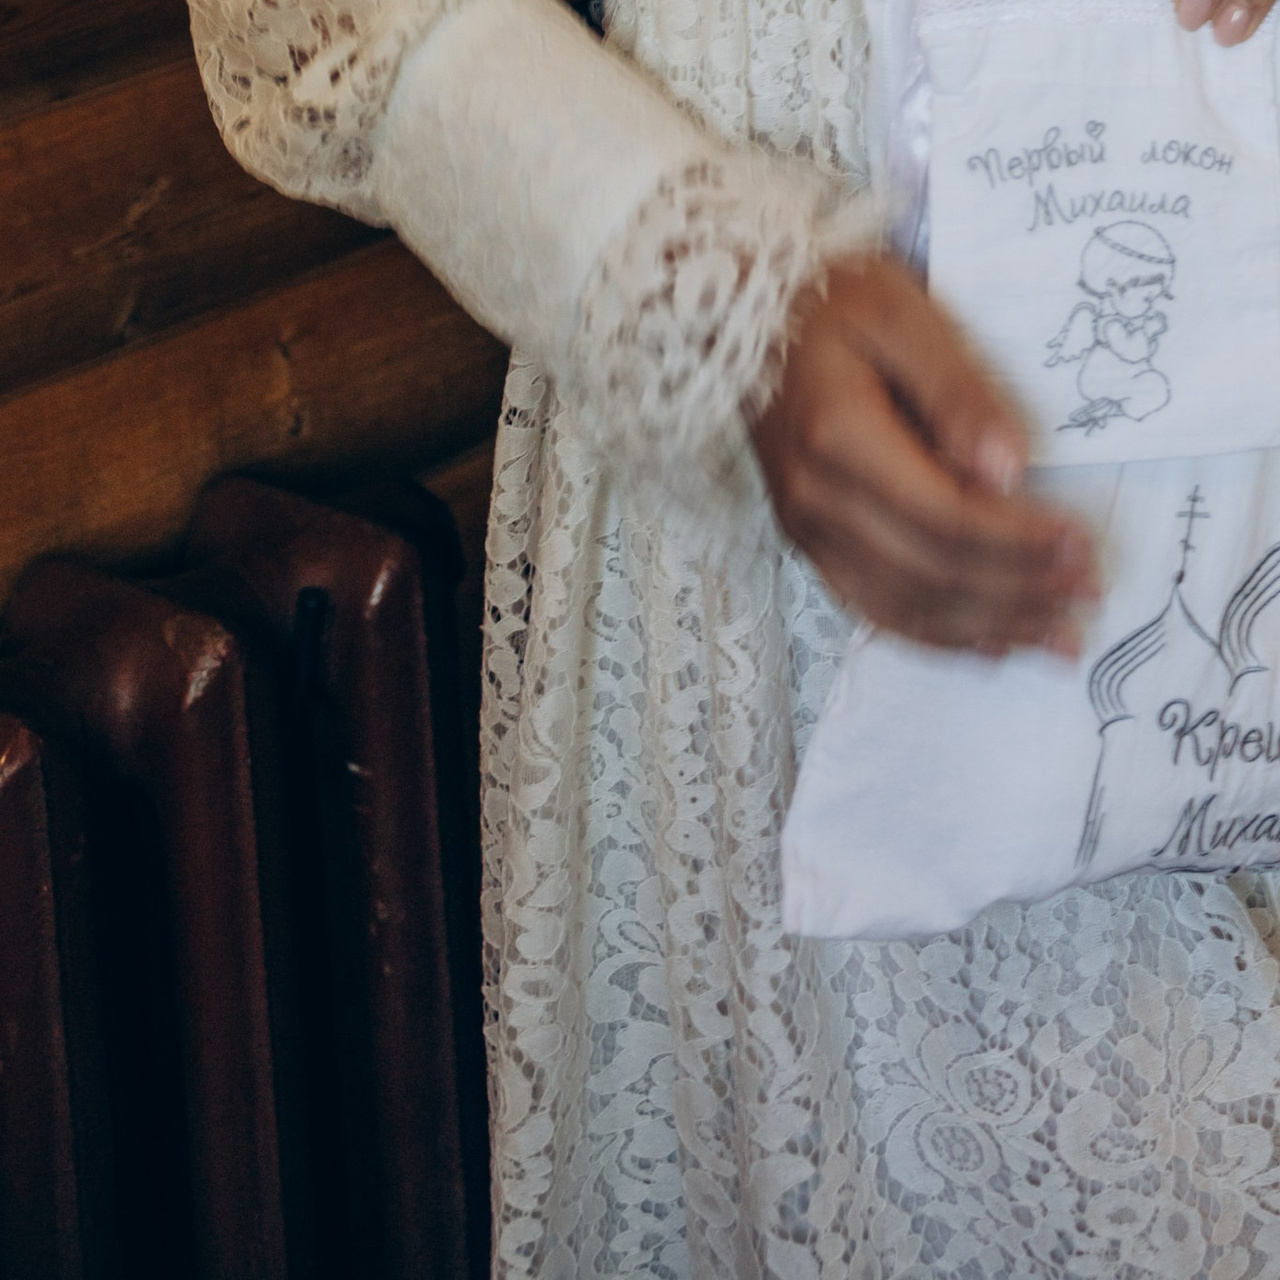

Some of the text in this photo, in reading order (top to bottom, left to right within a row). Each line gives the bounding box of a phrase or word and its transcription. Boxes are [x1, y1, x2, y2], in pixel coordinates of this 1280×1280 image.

[967, 119, 1234, 189] Первый локон
[1027, 182, 1192, 232] Михаила
